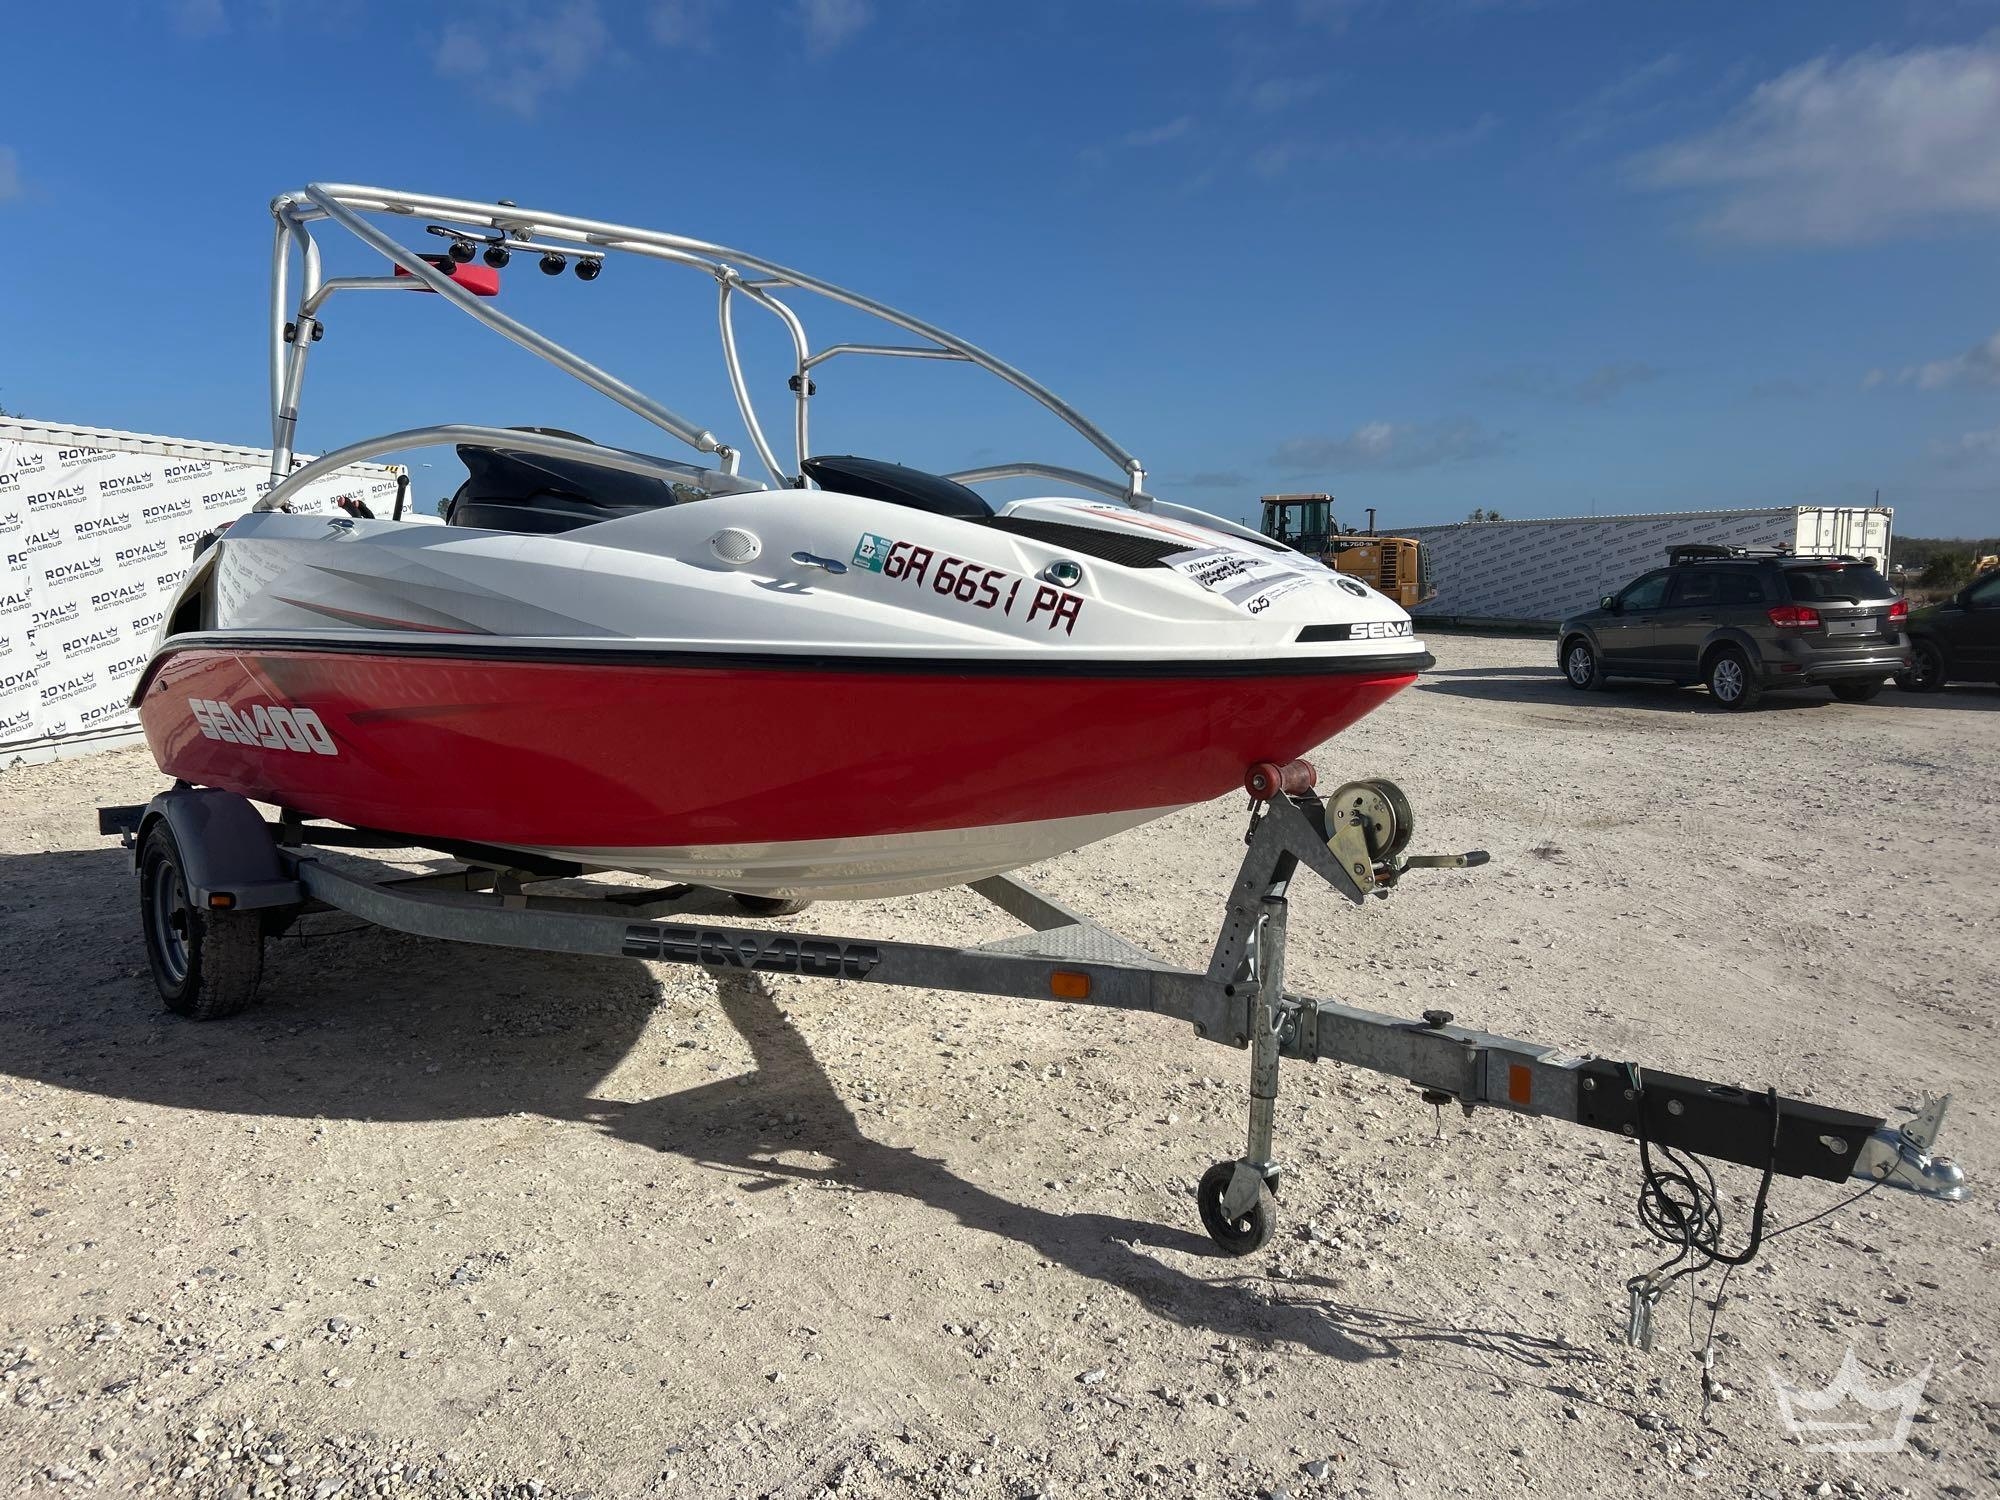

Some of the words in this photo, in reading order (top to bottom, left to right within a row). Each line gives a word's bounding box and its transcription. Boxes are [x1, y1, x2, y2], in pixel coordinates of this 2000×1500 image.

[164, 464, 202, 477] ROYAL
[99, 476, 142, 490] ROYAL
[27, 488, 73, 505] ROYAL
[203, 490, 237, 504] ROYAL
[142, 502, 182, 518] ROYAL
[74, 517, 119, 534] ROYAL
[25, 533, 48, 546] YAL
[116, 544, 156, 561] ROYAL
[862, 545, 876, 554] 27
[45, 561, 90, 580] ROYAL
[91, 586, 135, 605] ROYAL
[933, 557, 1023, 617] 6651
[1026, 585, 1084, 637] PA
[132, 612, 163, 630] ROYA
[62, 632, 107, 652] ROYAL
[80, 700, 124, 722] ROYAL
